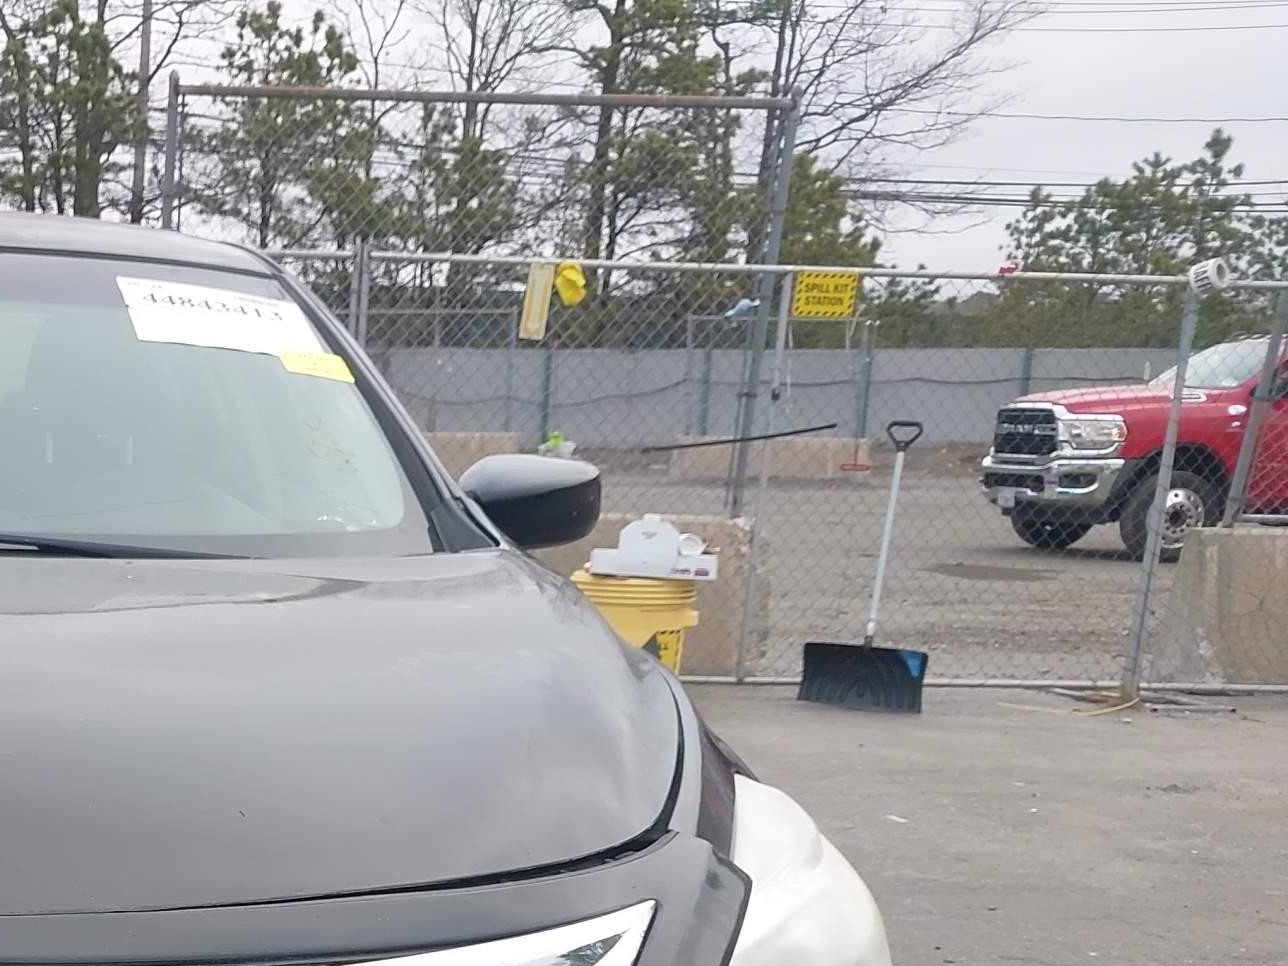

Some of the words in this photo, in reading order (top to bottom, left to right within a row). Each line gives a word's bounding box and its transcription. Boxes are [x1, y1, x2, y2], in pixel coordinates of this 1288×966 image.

[804, 282, 829, 293] SPILL
[833, 283, 850, 294] KIT
[804, 295, 844, 306] STATION
